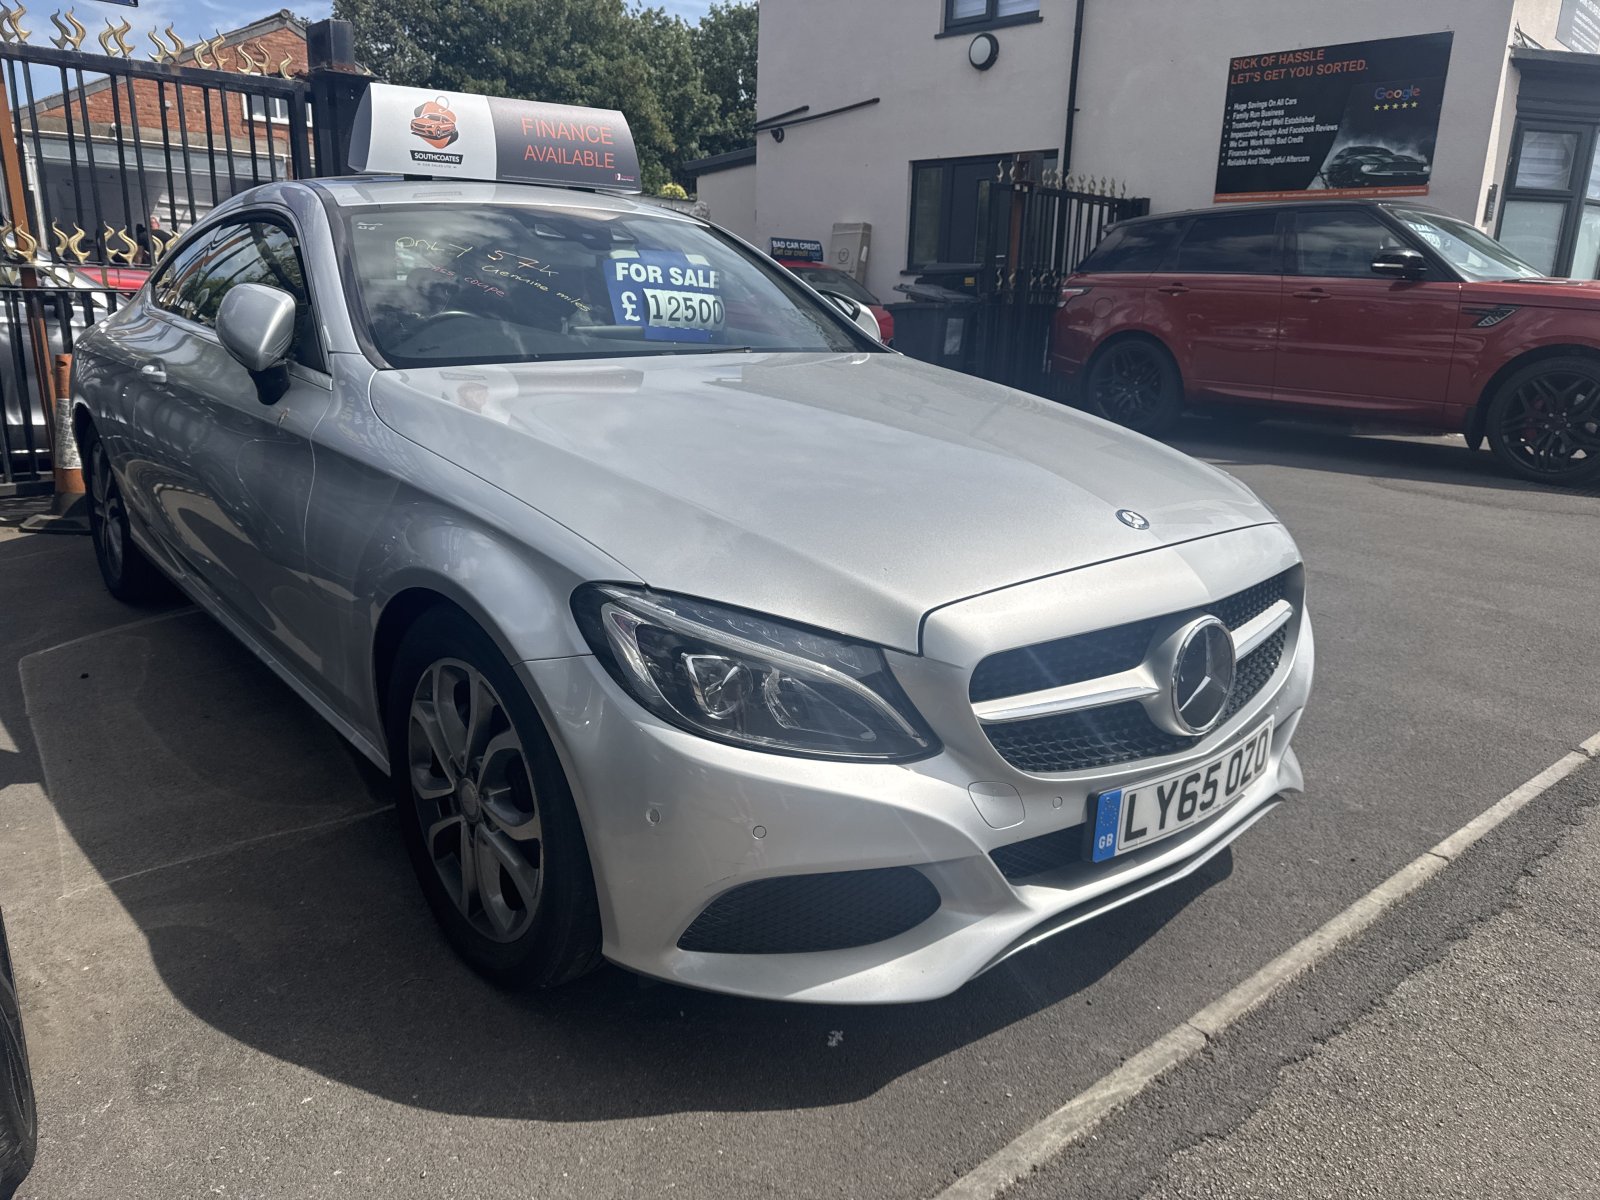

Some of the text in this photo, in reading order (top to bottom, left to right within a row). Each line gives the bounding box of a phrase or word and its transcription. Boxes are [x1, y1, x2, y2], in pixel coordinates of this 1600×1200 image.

[1232, 49, 1324, 70] SICK OF HASSLE
[1231, 60, 1368, 84] LET'S GET YOU SORTED.
[1375, 85, 1421, 100] Google
[1234, 103, 1247, 111] Huge
[1248, 101, 1267, 109] Savings
[1233, 112, 1248, 120] Family
[1285, 115, 1315, 124] Established
[521, 117, 614, 145] FINANCE
[1289, 126, 1314, 134] Facebook
[414, 152, 460, 162] SOUTHCOATES
[525, 144, 615, 169] AVAILABLE
[800, 242, 820, 250] CREDIT
[616, 262, 720, 289] FOR SALE
[621, 291, 724, 324] £ 12500
[1124, 731, 1269, 842] LY65 OZO
[1099, 833, 1113, 850] GB
